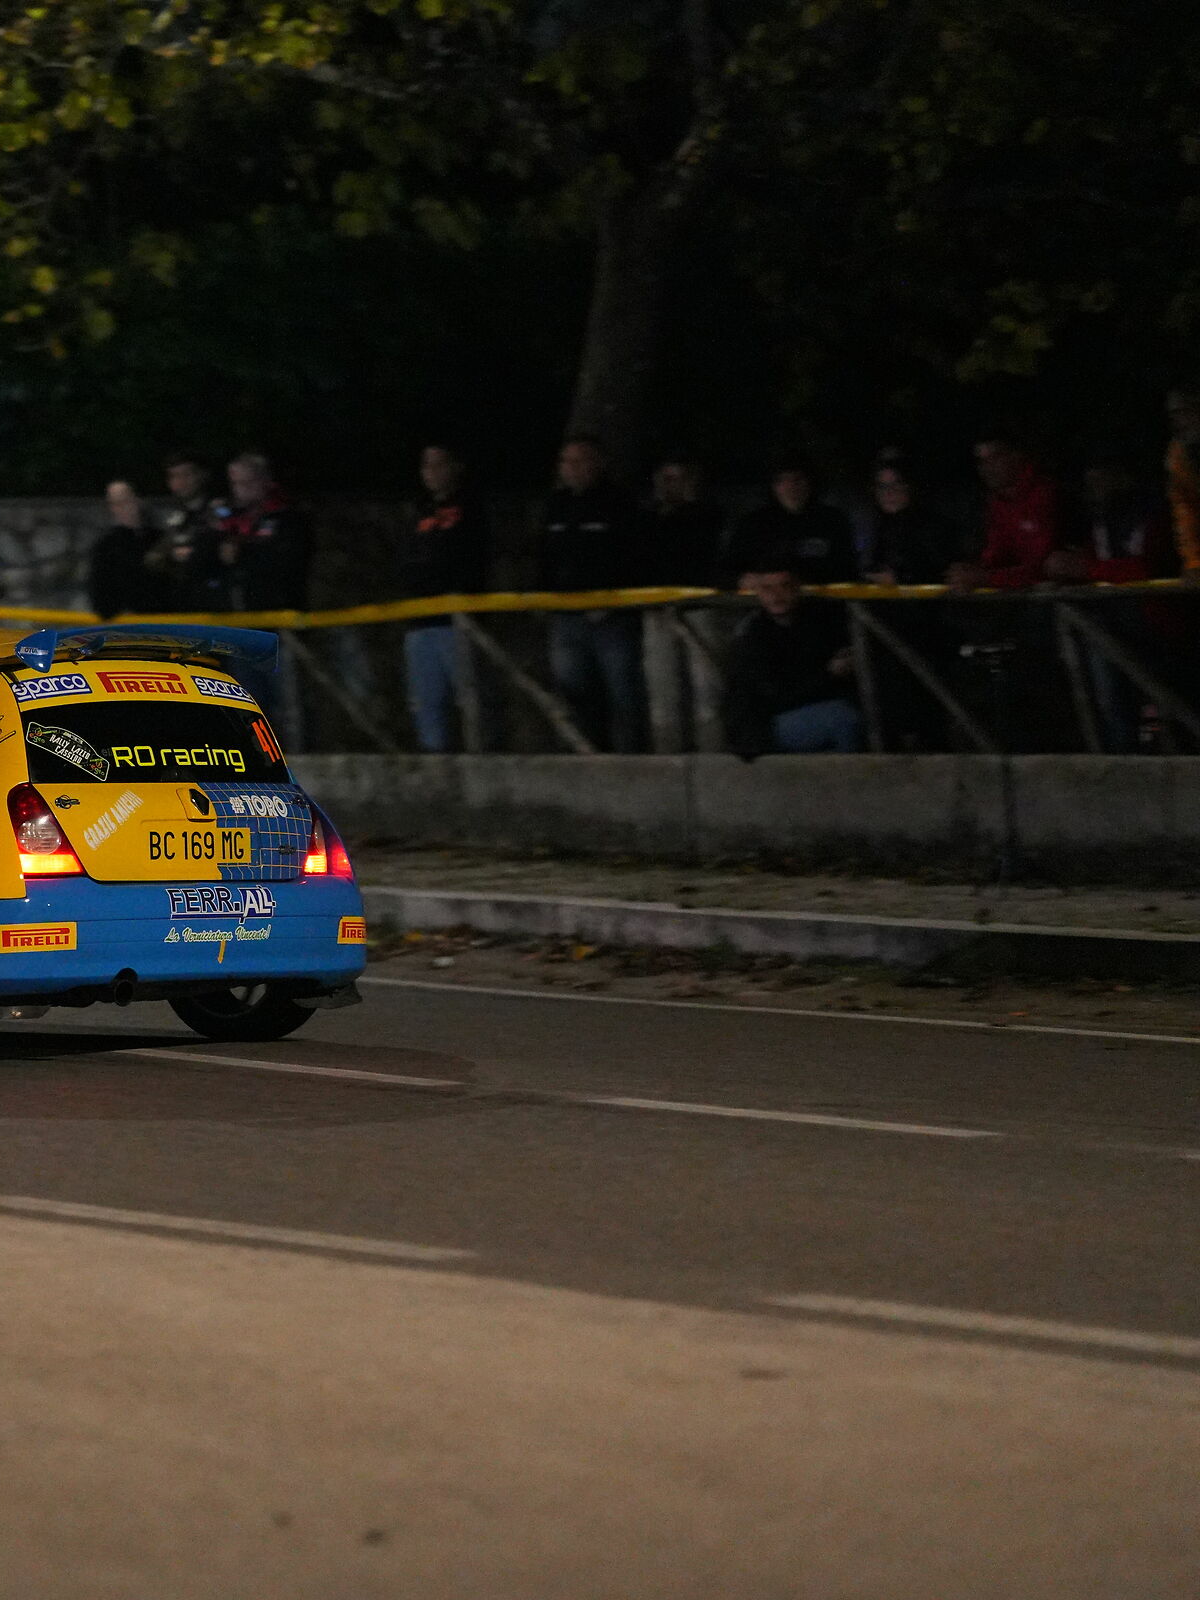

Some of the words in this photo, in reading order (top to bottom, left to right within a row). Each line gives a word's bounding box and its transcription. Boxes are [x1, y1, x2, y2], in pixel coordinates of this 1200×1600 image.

[13, 674, 87, 699] sparco
[96, 672, 188, 695] PIRELLI
[195, 677, 250, 699] sparco
[49, 734, 70, 749] RALLY
[251, 719, 280, 763] 41
[111, 745, 156, 767] RO
[160, 744, 246, 773] racing
[229, 795, 288, 818] #TORO
[149, 831, 176, 860] BC
[181, 831, 215, 860] 169
[221, 831, 244, 860] MG
[1, 927, 71, 948] PIRELLI
[164, 927, 180, 942] La
[182, 926, 233, 942] Verniciatura
[235, 923, 271, 941] Vincente!
